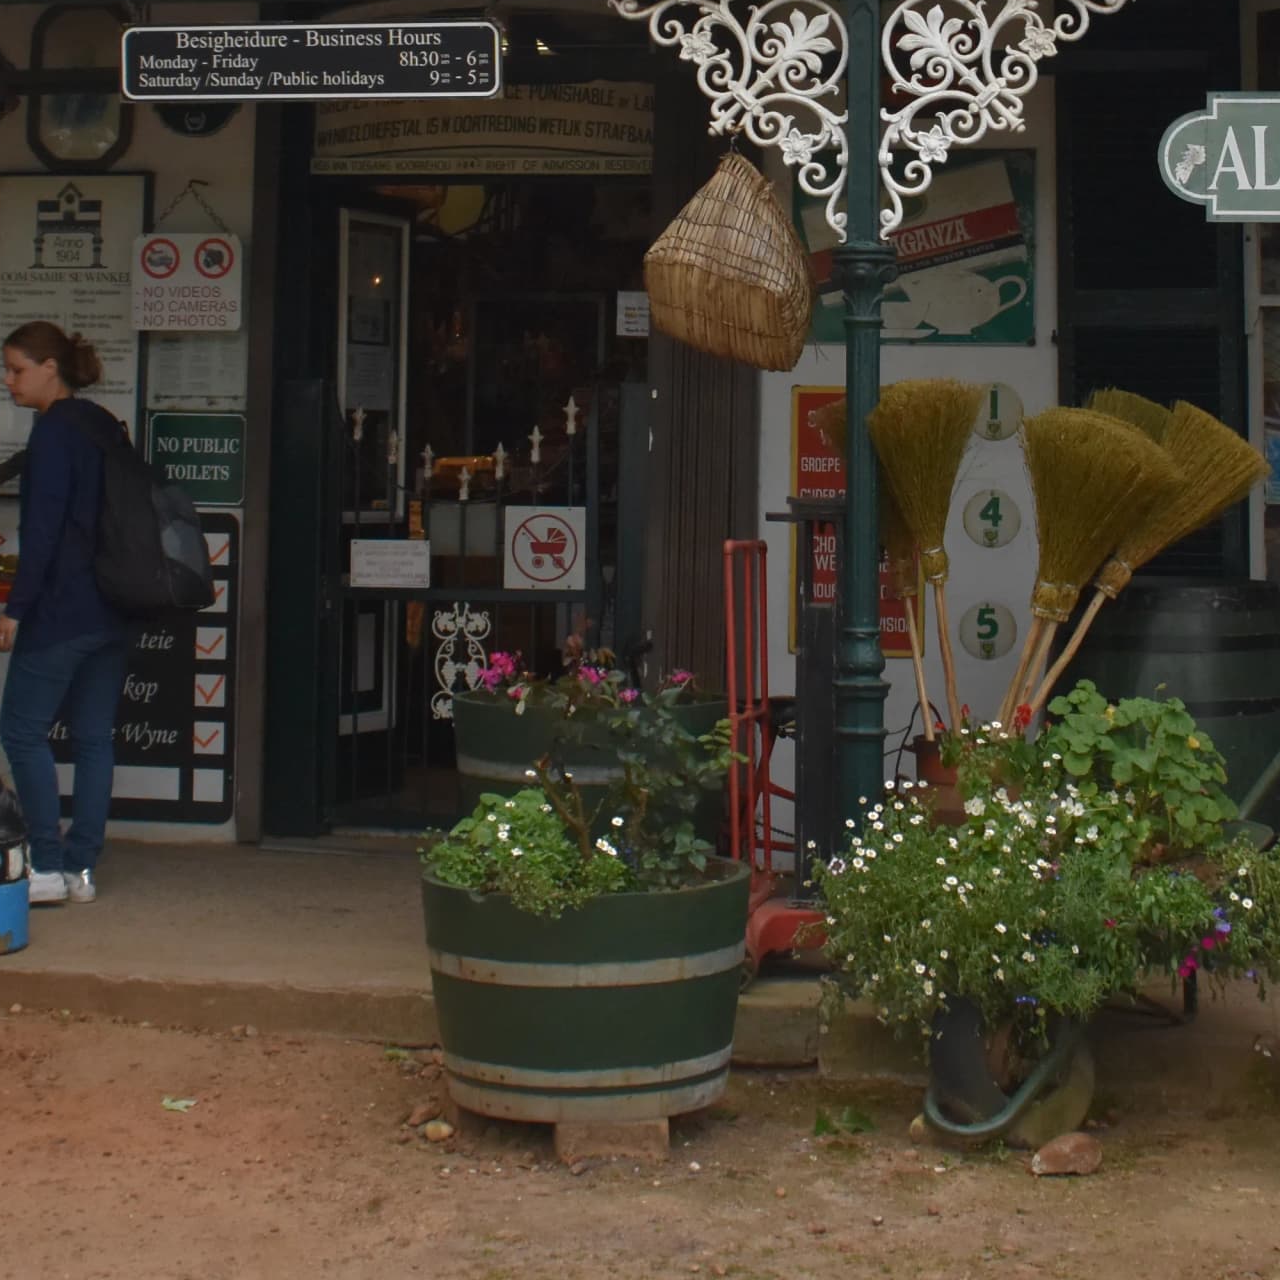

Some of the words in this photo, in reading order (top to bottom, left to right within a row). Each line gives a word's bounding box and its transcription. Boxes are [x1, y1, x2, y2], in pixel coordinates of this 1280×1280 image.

[176, 32, 289, 52] Besigheidure
[305, 30, 383, 48] Business
[387, 29, 442, 47] Hours
[139, 54, 198, 72] Monday
[212, 54, 260, 72] Friday
[138, 73, 202, 91] Saturday
[322, 70, 386, 88] holidays
[453, 114, 537, 135] OORTREDING
[584, 121, 656, 145] STRAFBAA
[52, 236, 85, 249] Anno
[143, 285, 165, 298] NO
[167, 285, 222, 298] VIDEOS
[143, 300, 165, 313] NO
[167, 300, 238, 313] CAMERAS
[143, 314, 165, 327] NO
[168, 314, 228, 327] PHOTOS
[156, 436, 180, 454] NO
[182, 436, 241, 455] PUBLIC
[164, 463, 231, 482] TOILETS
[979, 496, 1003, 527] 4
[976, 607, 999, 640] 5
[120, 720, 179, 751] Wyne
